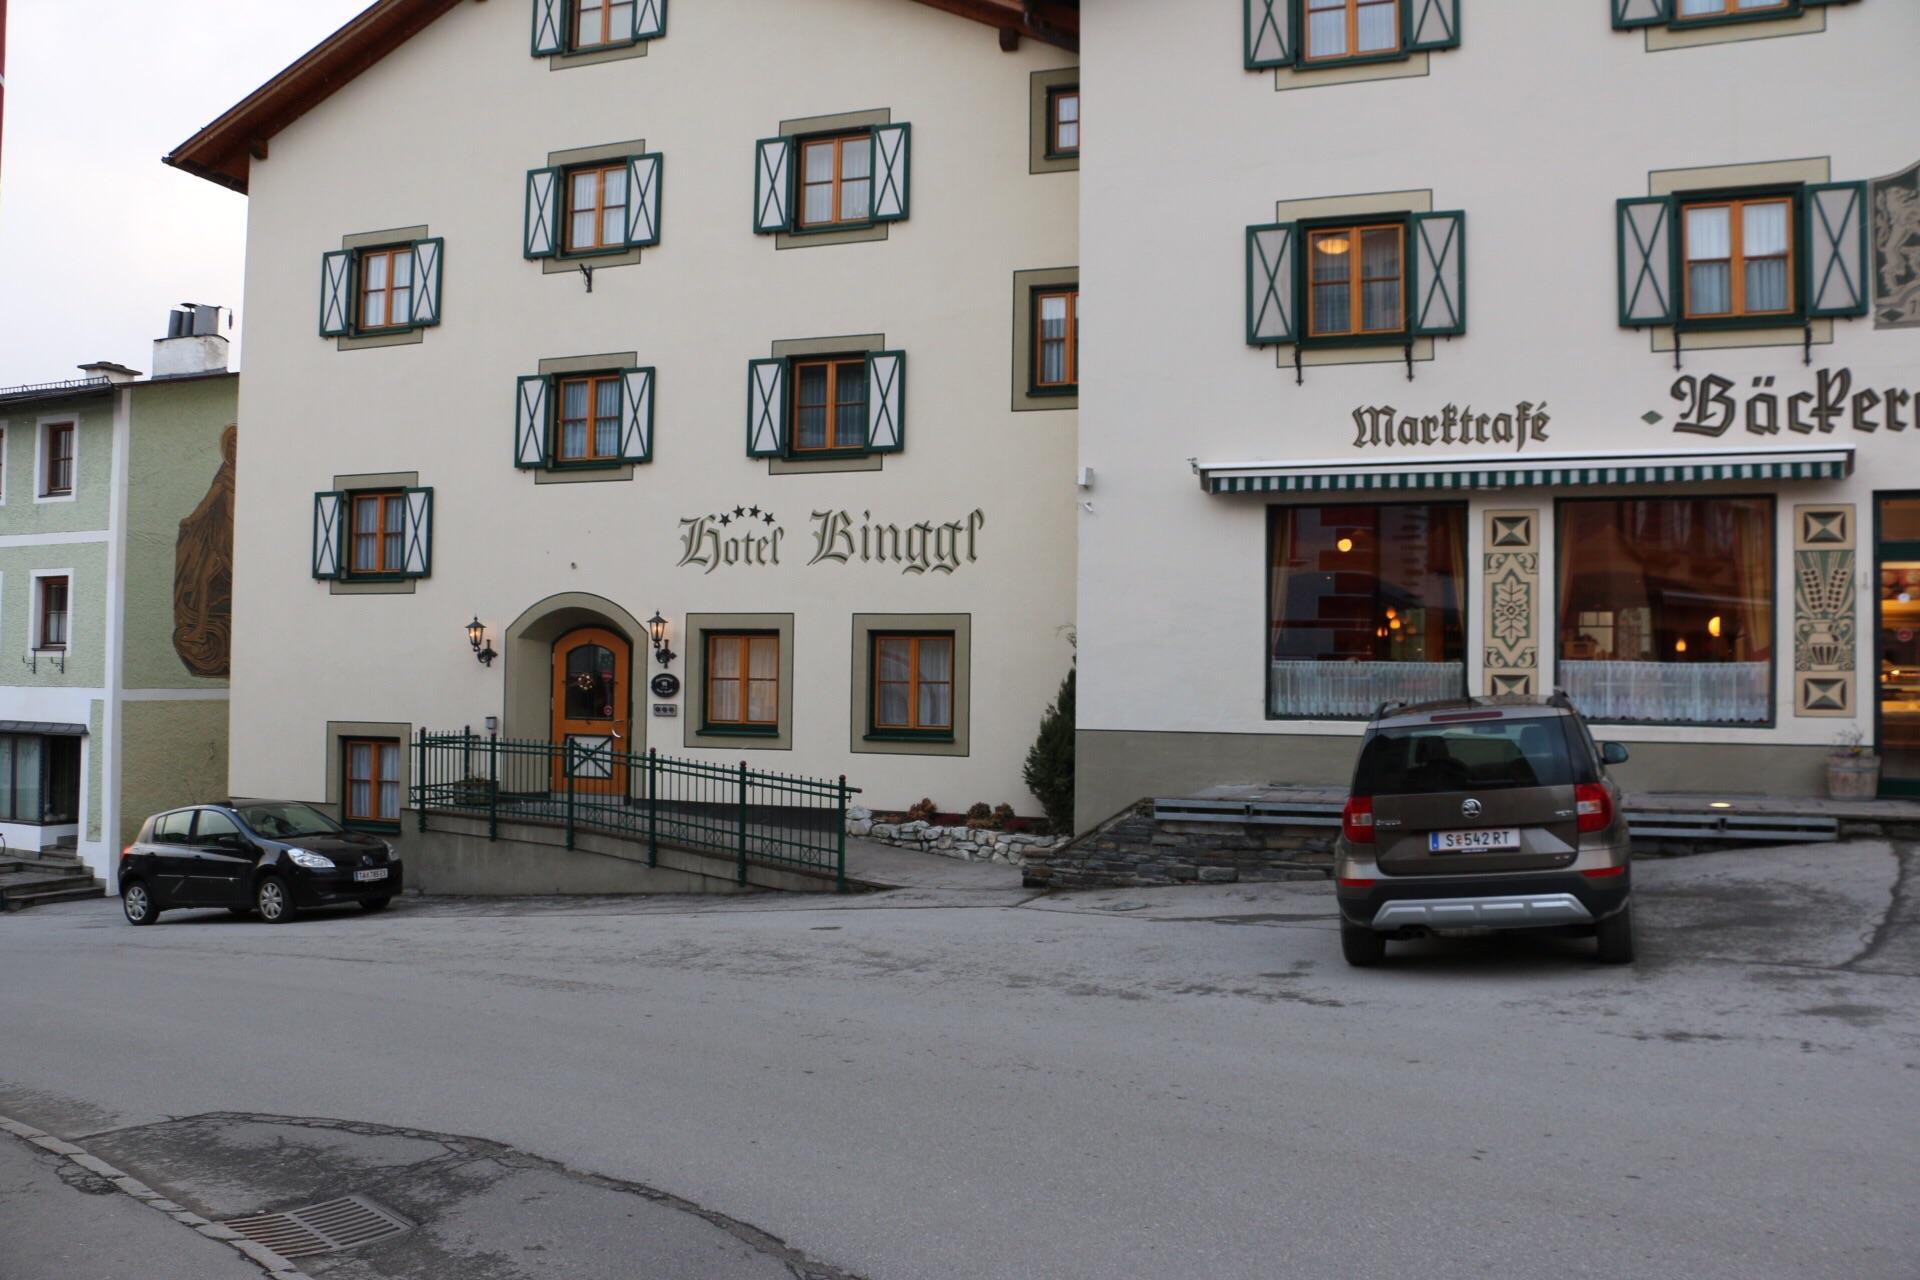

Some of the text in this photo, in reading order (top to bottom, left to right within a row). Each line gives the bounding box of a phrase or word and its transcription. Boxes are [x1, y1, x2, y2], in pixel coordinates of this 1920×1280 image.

[1351, 400, 1551, 453] Marktcafé
[1670, 367, 1920, 438] Bäcker
[676, 507, 985, 576] Hotel Binggl
[1445, 833, 1455, 848] S
